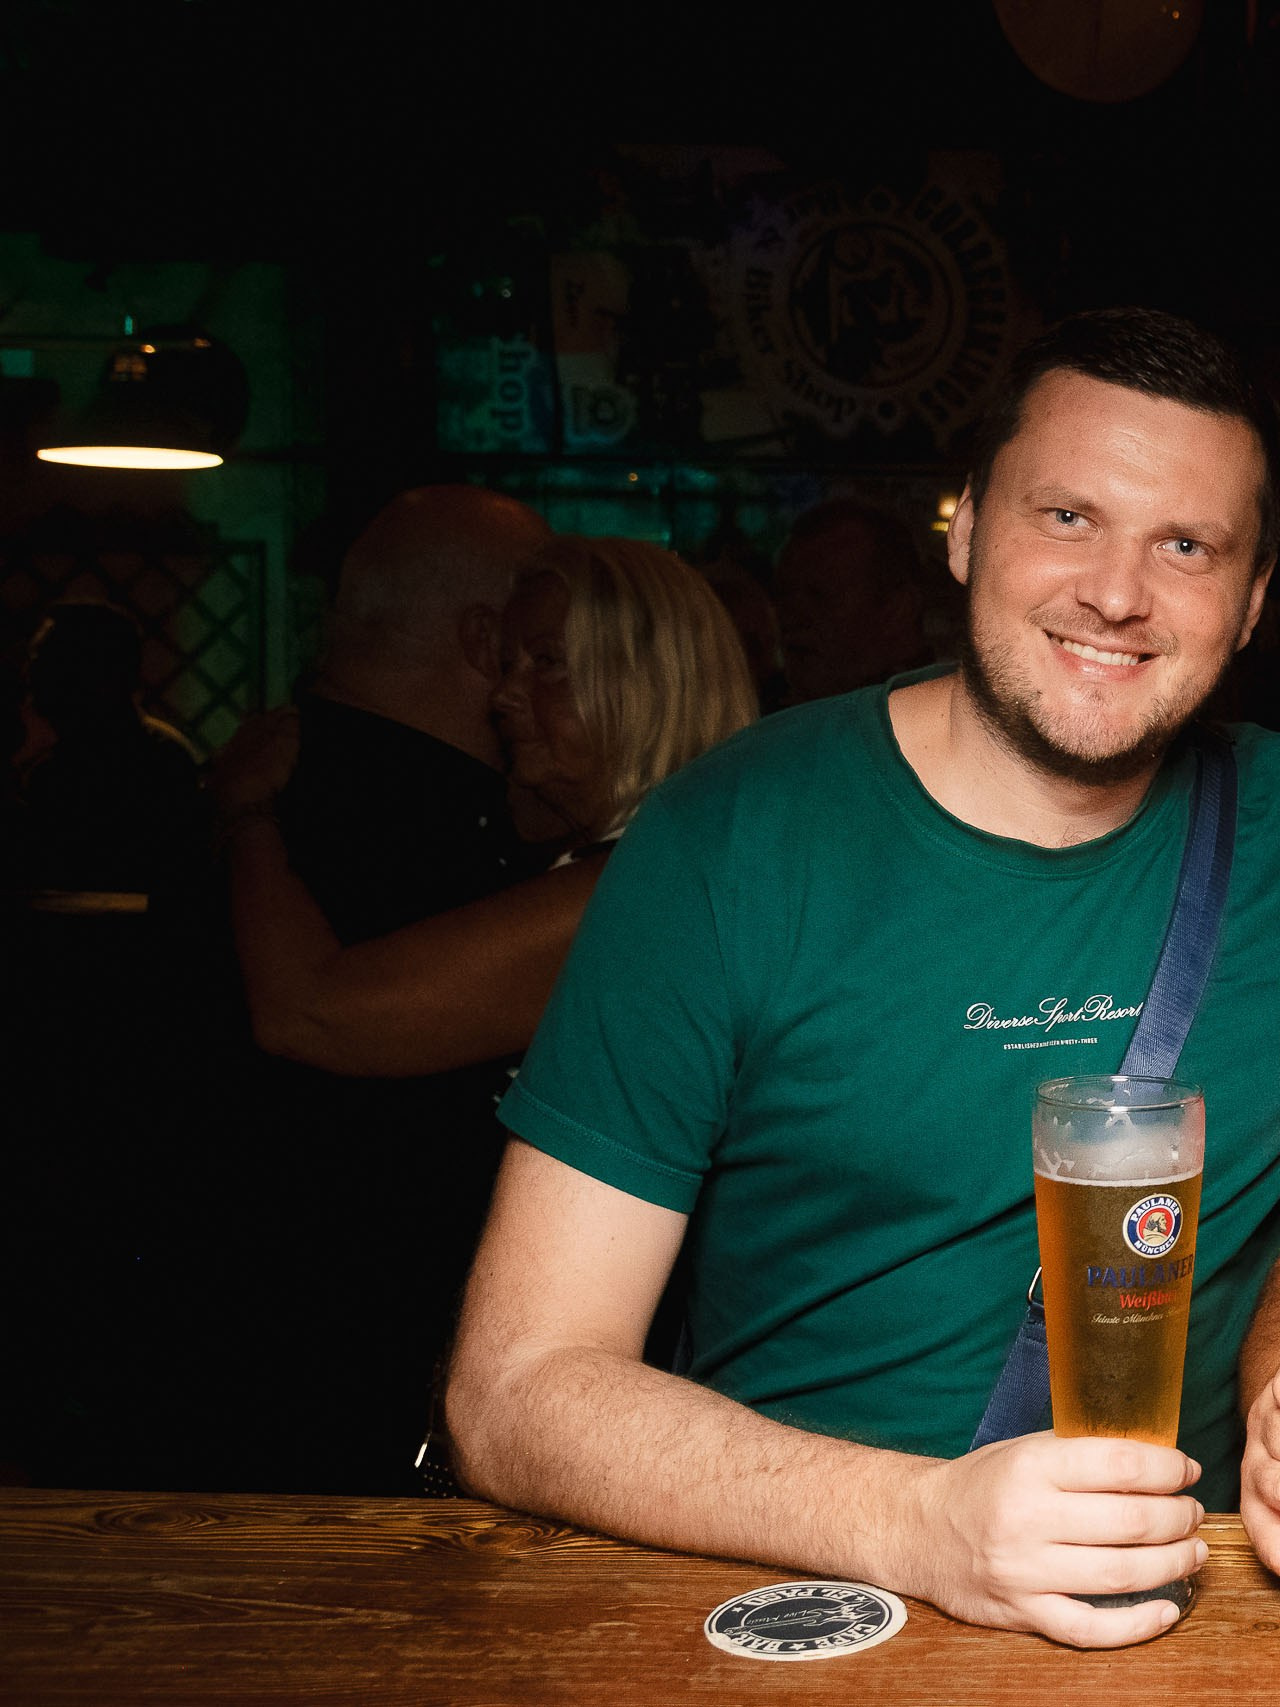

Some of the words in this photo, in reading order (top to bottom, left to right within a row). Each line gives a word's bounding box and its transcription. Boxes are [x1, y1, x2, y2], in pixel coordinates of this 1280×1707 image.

[964, 1003, 1035, 1030] Diverse
[1034, 997, 1085, 1033] Sport
[1082, 994, 1144, 1021] Resort
[1130, 1197, 1181, 1222] PAULANER
[1133, 1235, 1175, 1255] MÜNCHEN
[1087, 1253, 1194, 1289] PAULANER
[742, 1586, 816, 1606] PASO
[821, 1587, 855, 1598] EL
[783, 1610, 809, 1618] Live
[734, 1632, 784, 1651] BAR
[815, 1624, 879, 1650] CAFE
